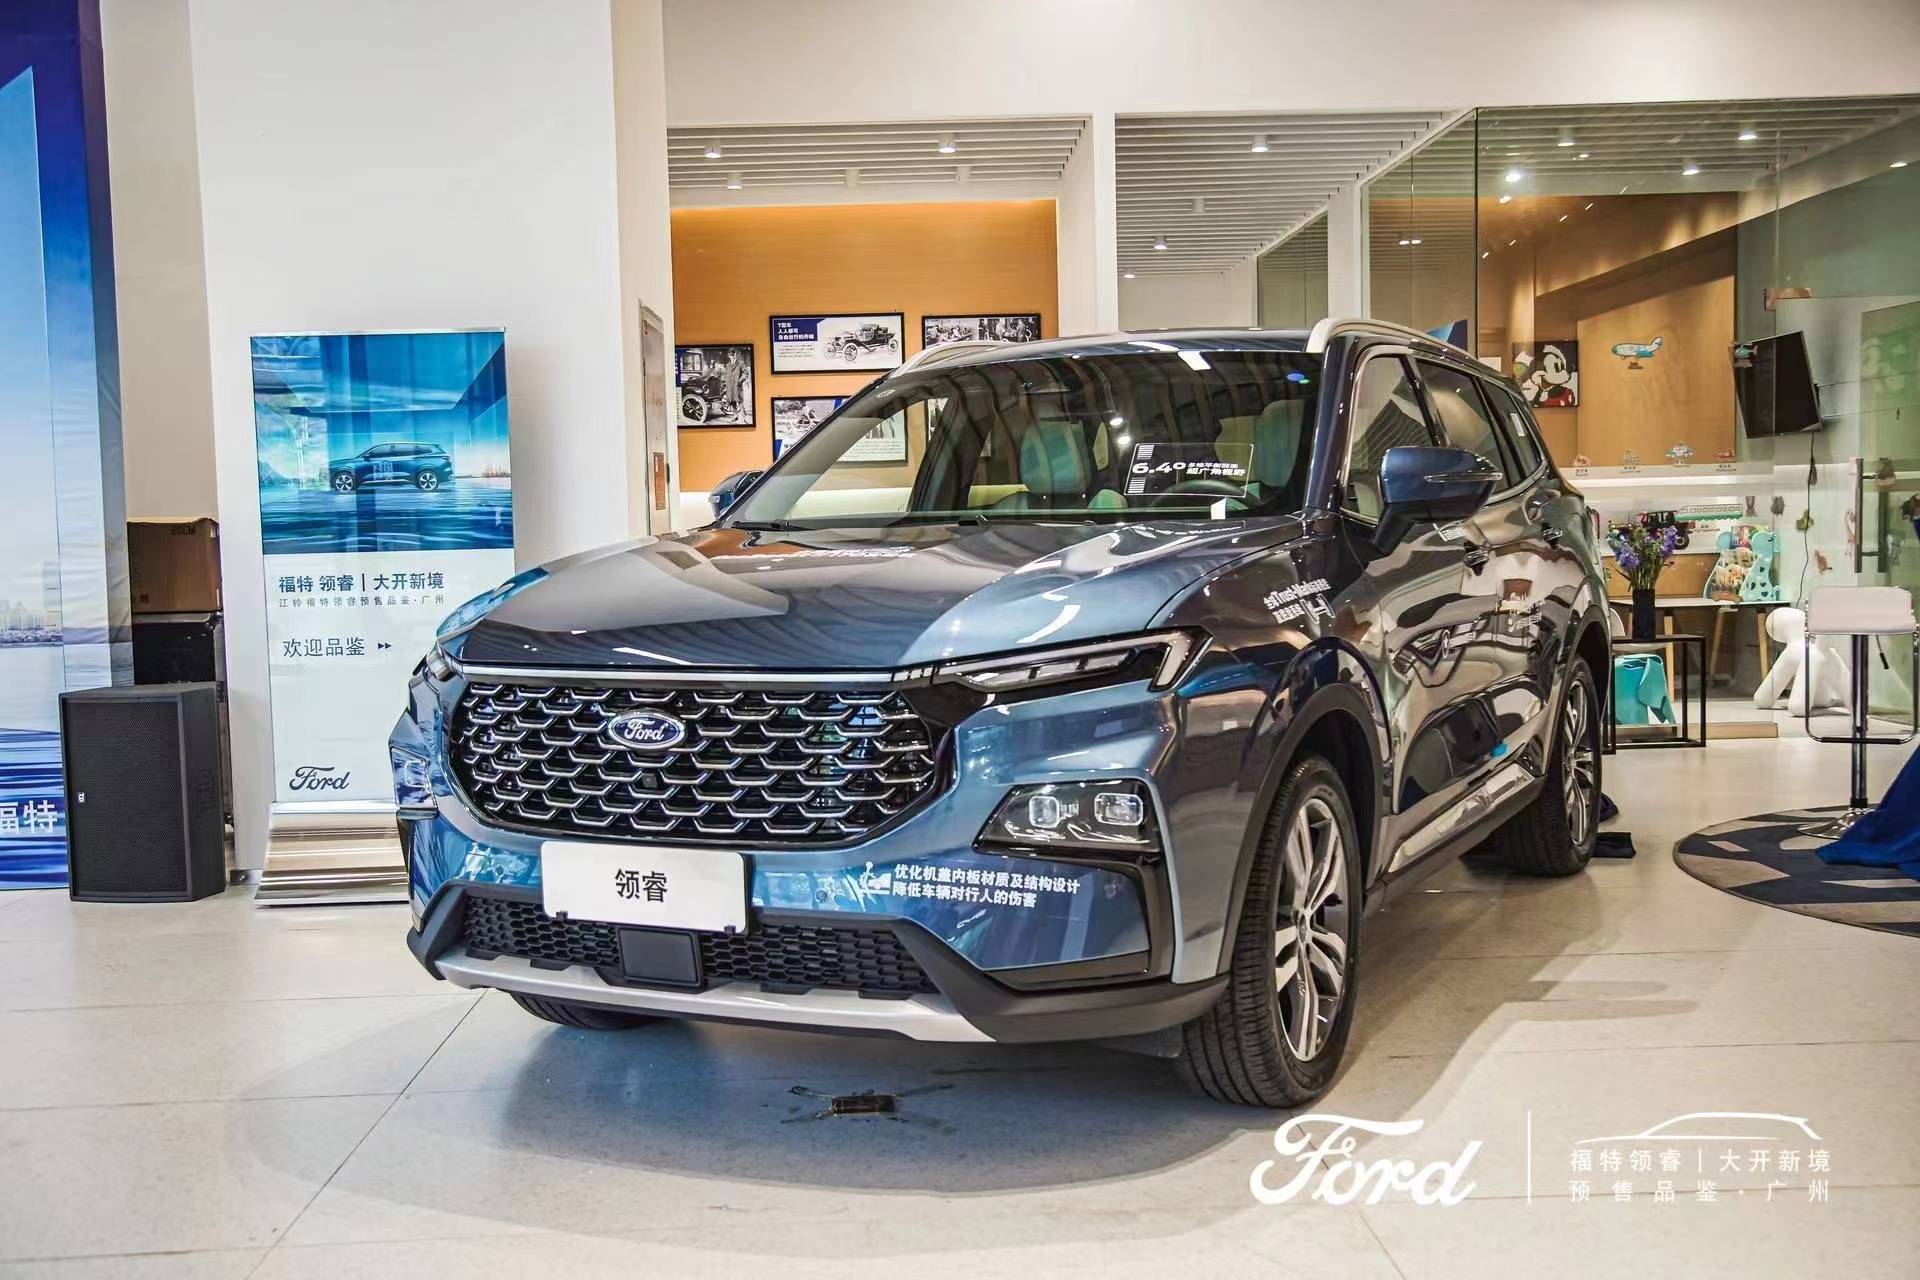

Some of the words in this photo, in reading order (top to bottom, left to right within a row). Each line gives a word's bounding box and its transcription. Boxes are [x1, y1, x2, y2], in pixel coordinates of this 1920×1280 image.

[278, 575, 314, 593] 福特
[318, 574, 354, 592] 领睿
[373, 571, 445, 591] 大开新境
[282, 636, 366, 658] 欢迎品鉴
[623, 718, 669, 742] Ford
[288, 765, 351, 791] Ford
[614, 868, 669, 903] 领睿
[894, 862, 1081, 895] 优化机盖内板材质及结构设计
[892, 881, 1038, 908] 降低车辆对行人的伤害
